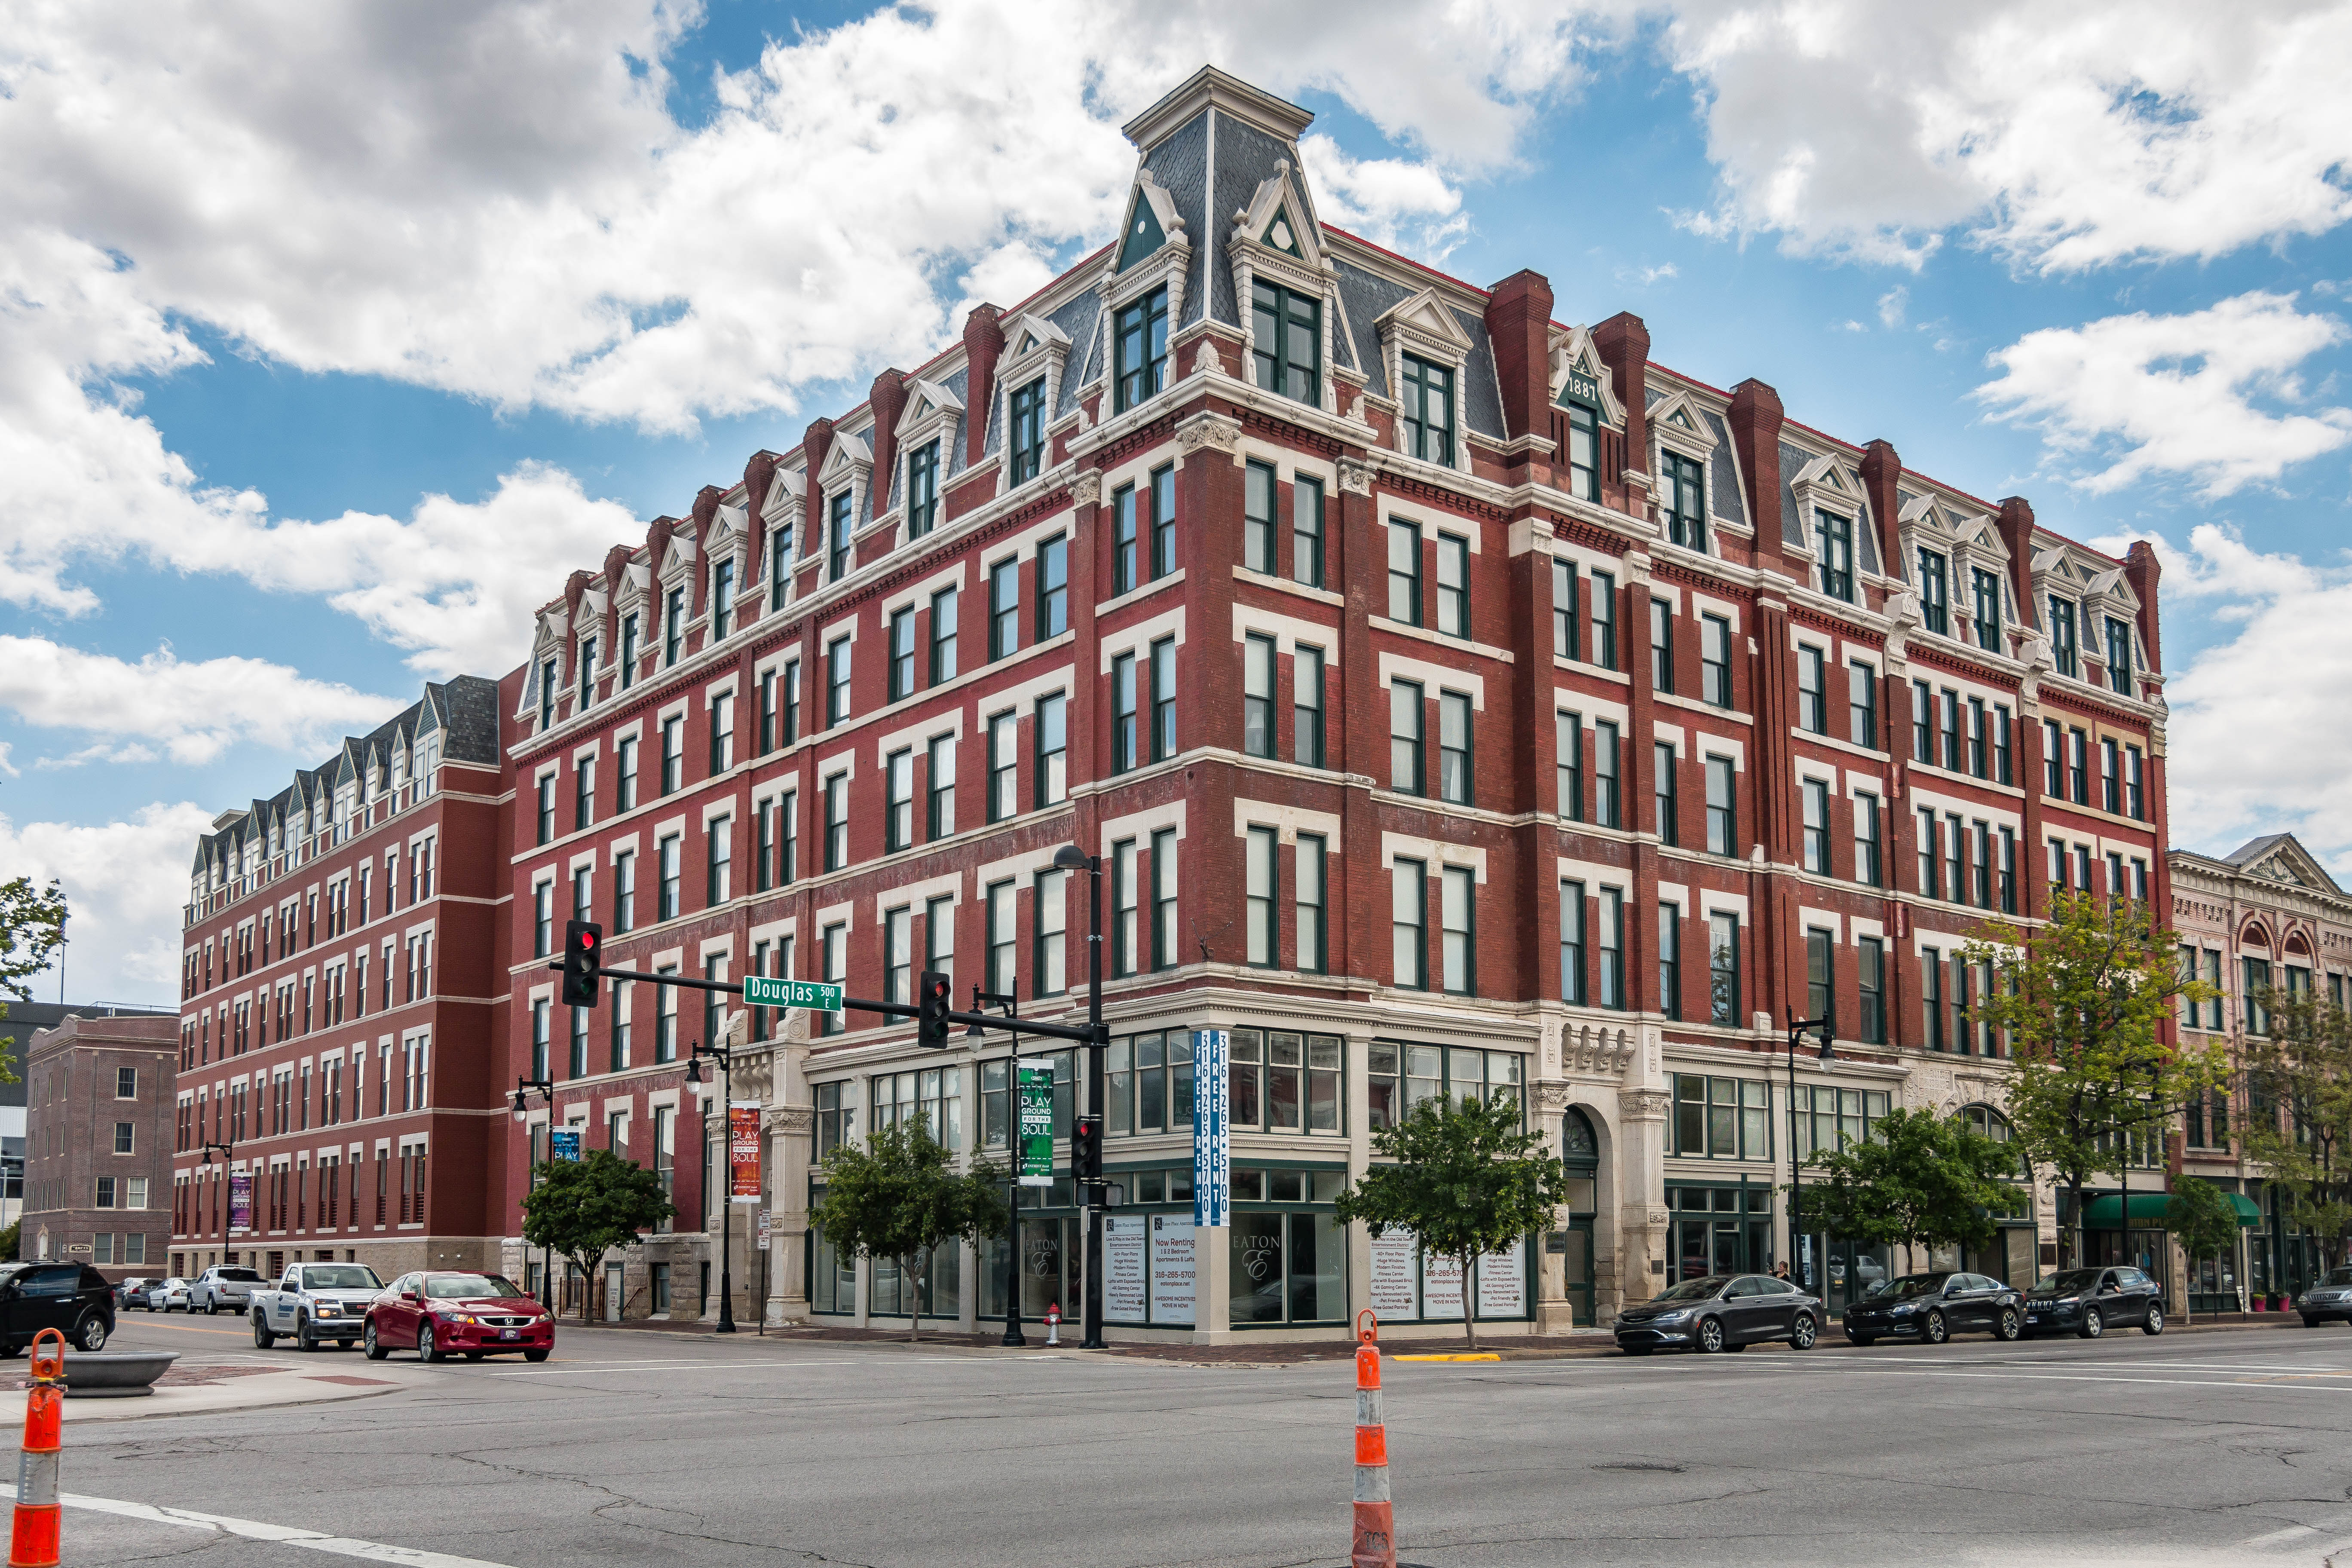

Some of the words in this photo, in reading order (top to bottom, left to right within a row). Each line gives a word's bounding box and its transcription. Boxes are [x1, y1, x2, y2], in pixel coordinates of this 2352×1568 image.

[1569, 377, 1596, 401] 1887
[752, 978, 813, 1006] Douglas
[821, 986, 835, 997] 500
[825, 998, 829, 1008] E
[1021, 1096, 1051, 1108] PLAY
[732, 1131, 759, 1139] PLAY
[1022, 1124, 1051, 1135] SOUL
[733, 1153, 758, 1162] SOUL
[1155, 1238, 1169, 1246] Now
[1170, 1238, 1195, 1249] Renting
[1234, 1236, 1279, 1248] EATON
